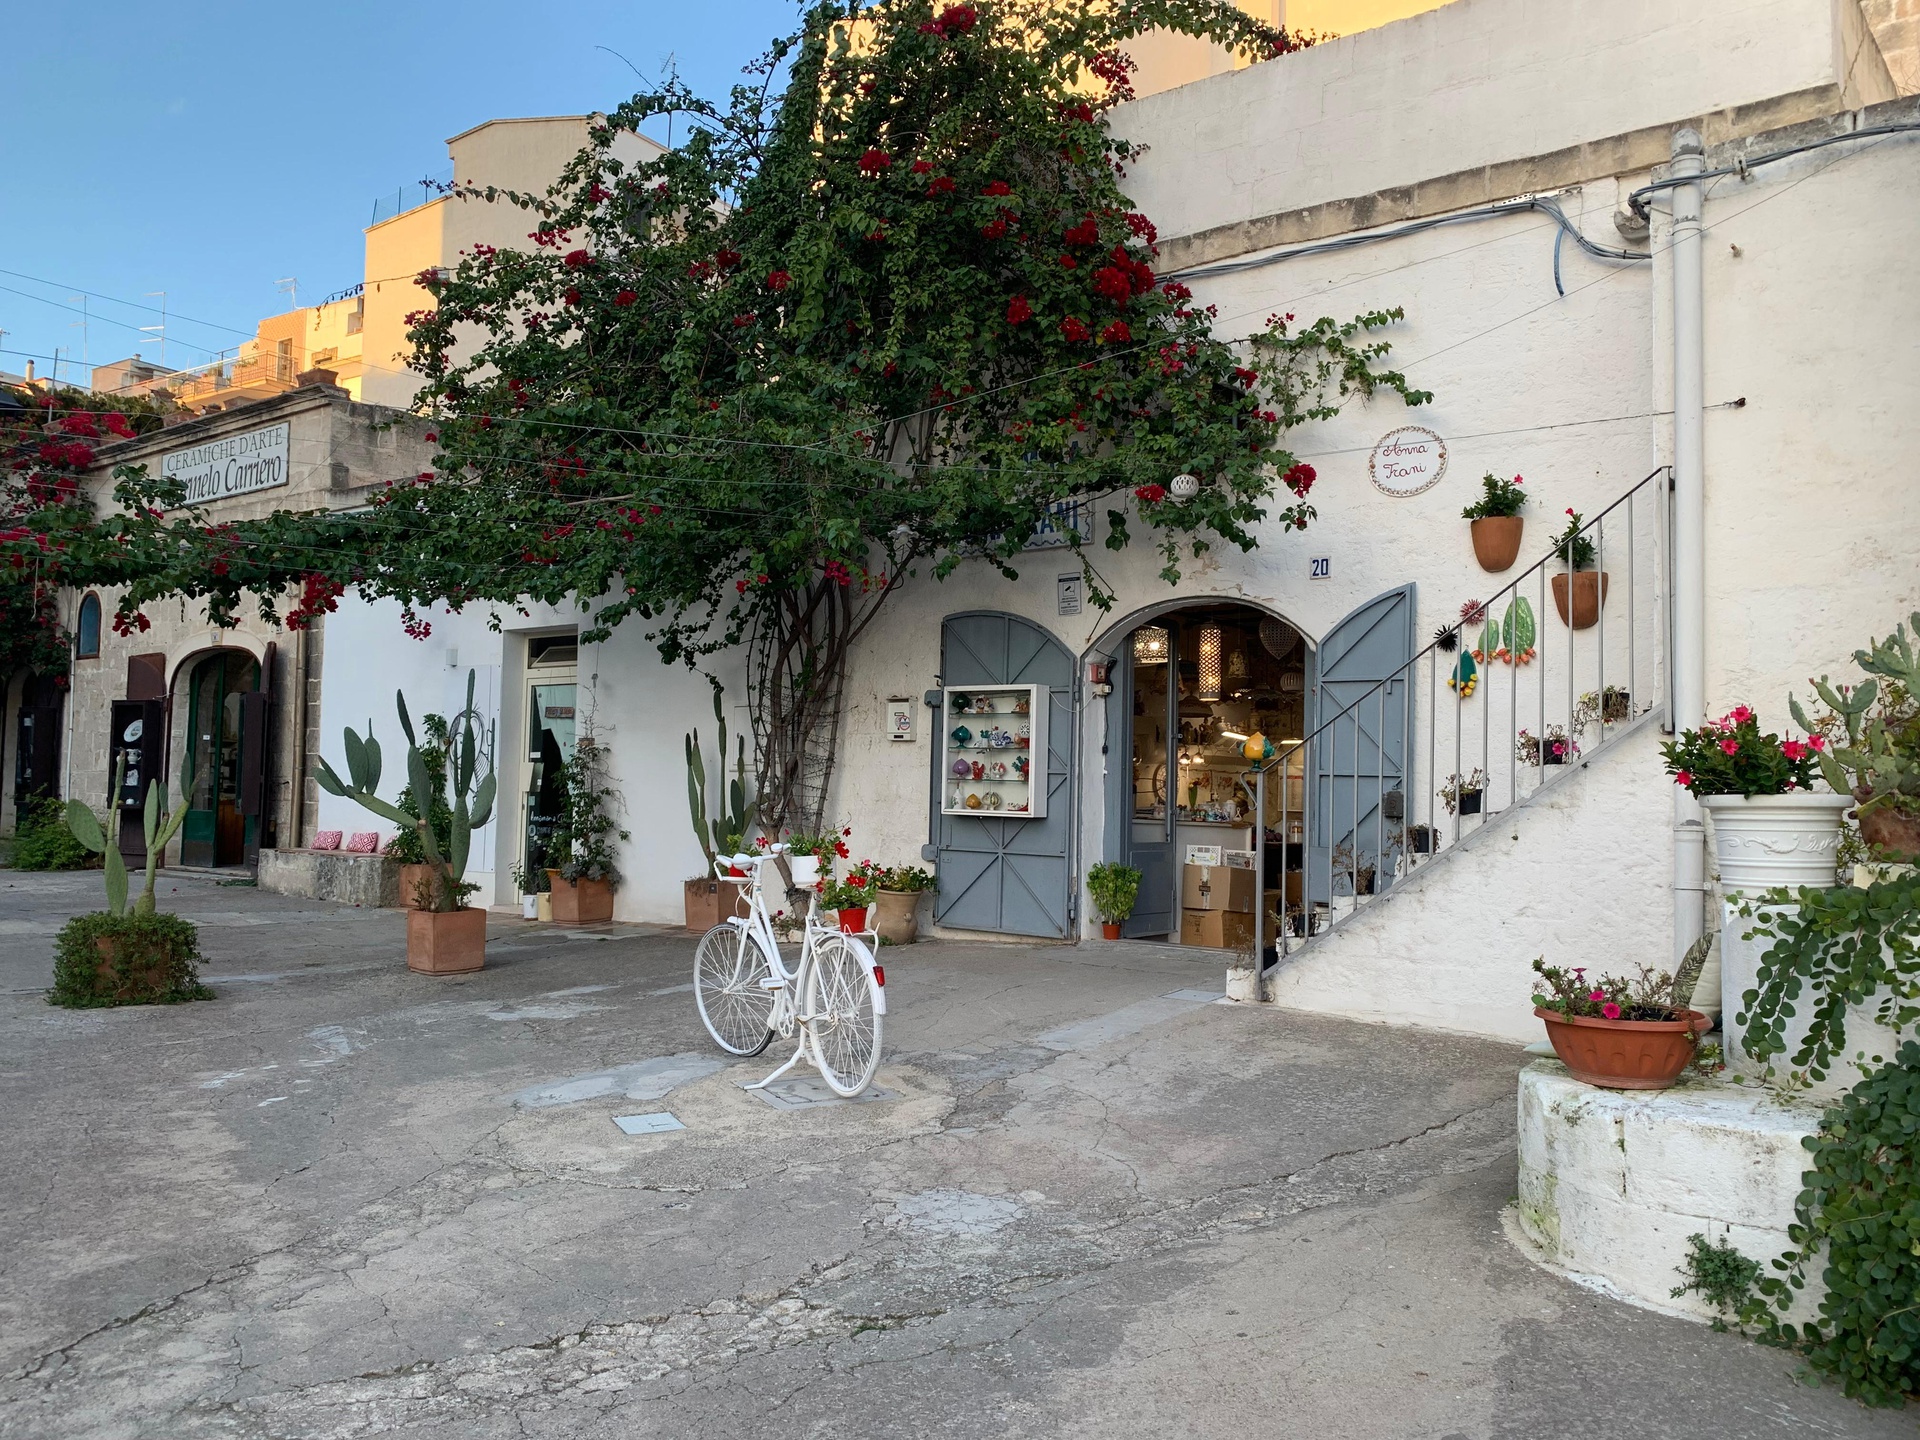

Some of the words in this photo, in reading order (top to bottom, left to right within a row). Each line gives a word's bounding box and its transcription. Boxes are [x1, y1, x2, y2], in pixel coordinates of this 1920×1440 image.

[167, 439, 236, 472] CERAMICHE
[239, 427, 283, 454] D'ARTE
[1383, 437, 1429, 457] Anna
[170, 465, 220, 501] rmelo
[225, 452, 281, 492] Carriero
[1312, 558, 1329, 576] 20
